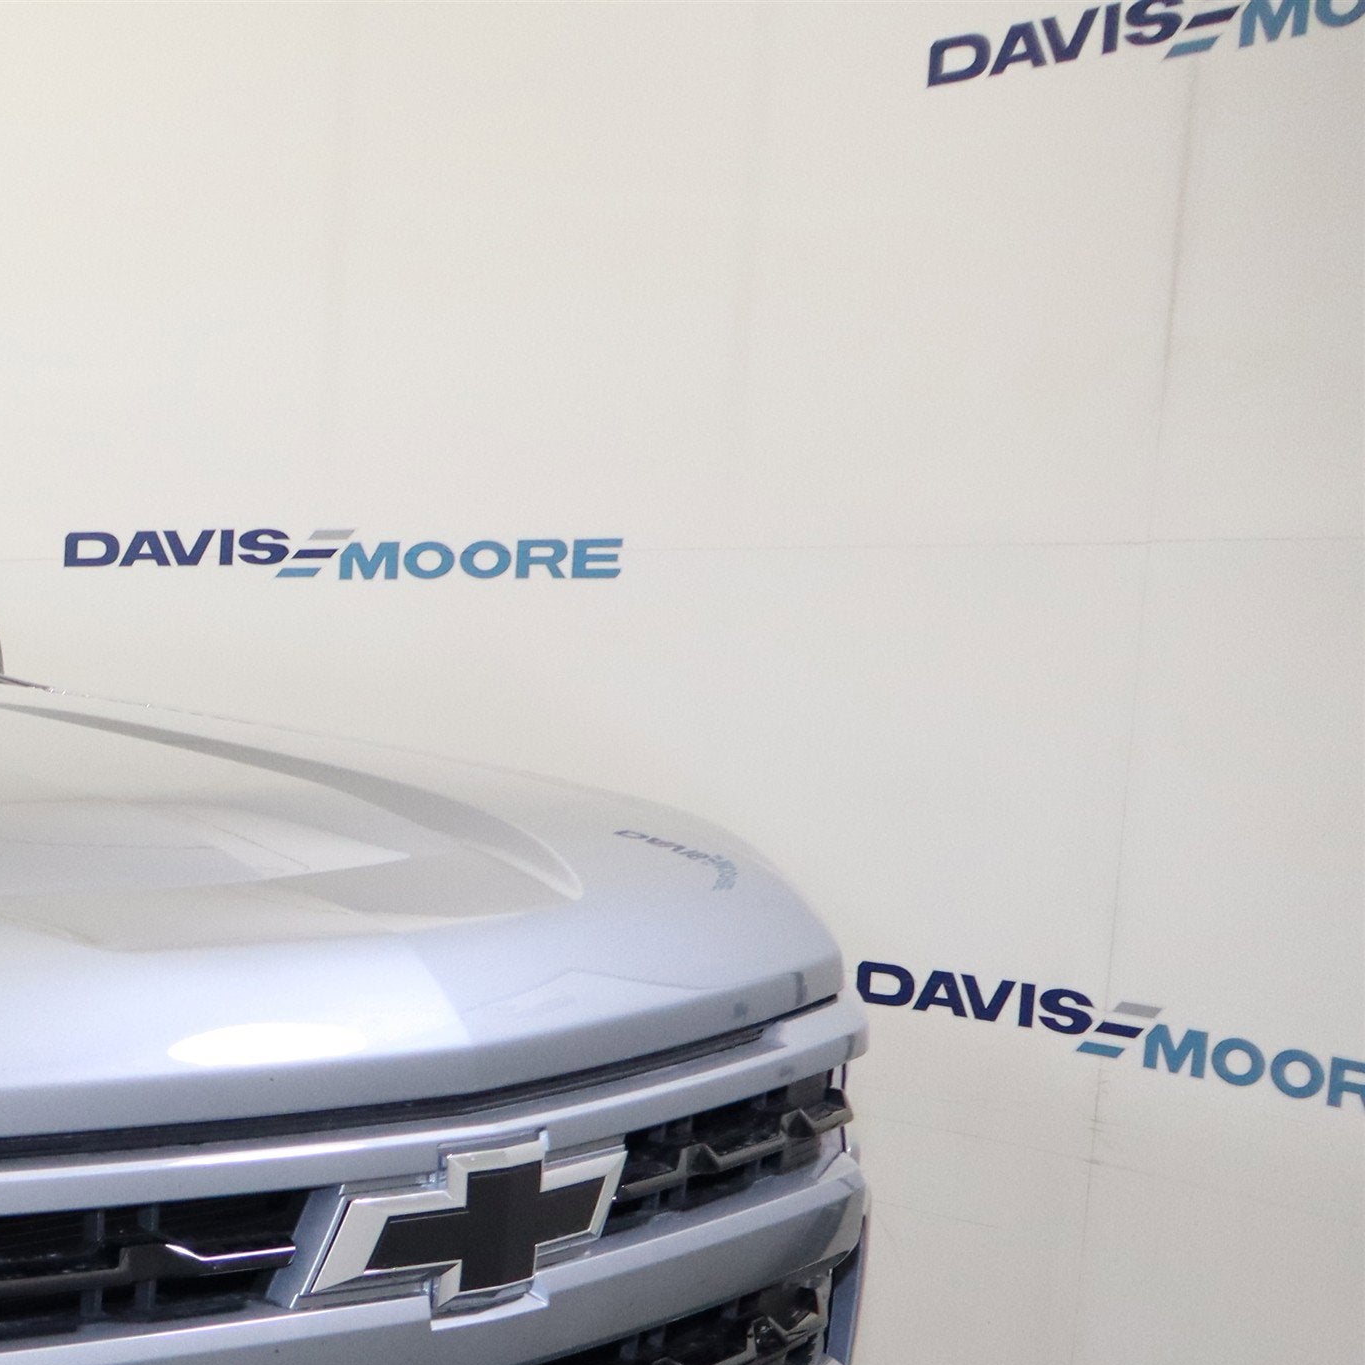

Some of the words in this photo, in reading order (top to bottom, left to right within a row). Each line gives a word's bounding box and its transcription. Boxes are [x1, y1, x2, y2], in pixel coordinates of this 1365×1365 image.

[927, 0, 1185, 88] DAVIS
[63, 527, 291, 568] DAVIS
[338, 537, 624, 581] MOORE
[855, 960, 1095, 1036] DAVIS
